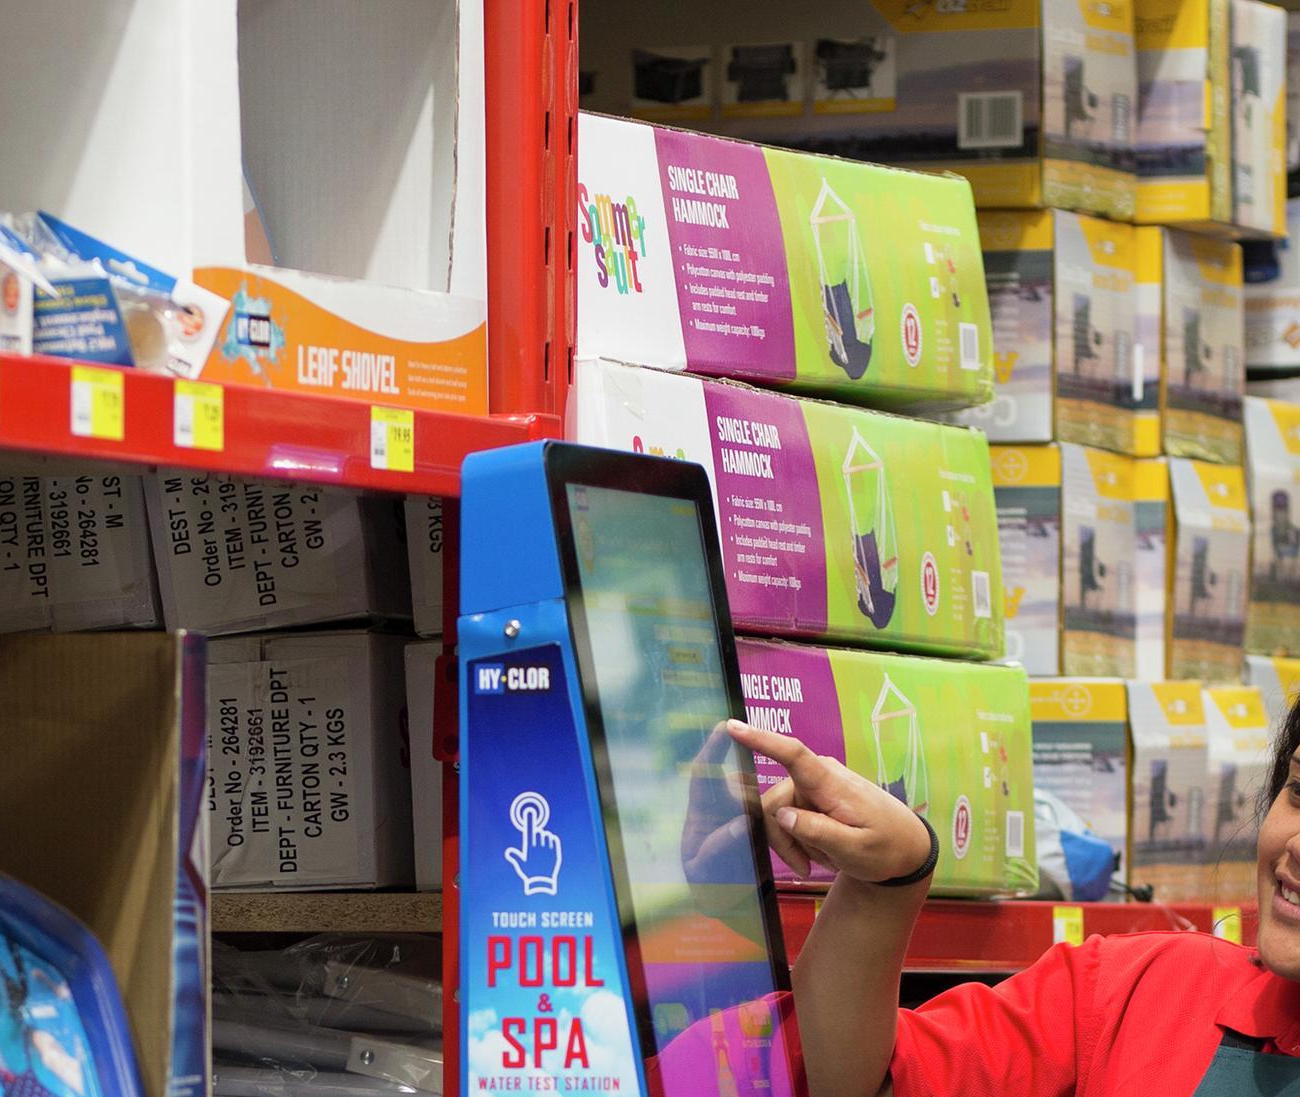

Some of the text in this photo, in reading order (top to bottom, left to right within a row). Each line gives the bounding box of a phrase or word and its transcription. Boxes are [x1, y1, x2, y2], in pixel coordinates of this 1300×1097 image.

[668, 165, 739, 199] SINGLE CHAIR
[672, 197, 729, 229] HAMMOCK
[595, 234, 643, 295] sault
[298, 344, 339, 388] LEAF
[342, 349, 399, 395] SHOVEL
[717, 415, 781, 449] SINGLE CHAIR
[721, 448, 774, 479] HAMMOCK
[0, 512, 19, 547] QTY
[50, 491, 71, 557] 3192661
[77, 510, 99, 567] 264281
[105, 513, 124, 529] M
[165, 478, 191, 555] DEST M
[197, 510, 214, 535] No
[273, 492, 299, 568] CARTON
[304, 519, 325, 550] GW
[202, 536, 221, 587] Order
[222, 527, 246, 571] ITEM
[29, 563, 48, 598] DPT
[254, 560, 277, 606] DEPT
[771, 676, 804, 703] CHAIR
[299, 721, 319, 757] QTY
[220, 697, 244, 847] Order No 264281
[247, 708, 270, 833] ITEM 3192661
[269, 668, 297, 873] DEPT FURNITURE DPT
[326, 708, 349, 822] GW 2.3 KGS
[302, 763, 323, 838] CARTON
[492, 911, 593, 928] TOUCH SCREEN
[487, 935, 605, 988] POOL
[536, 993, 553, 1013] &
[501, 1017, 590, 1070] SPA
[478, 1076, 620, 1092] WATER TEST STATION
